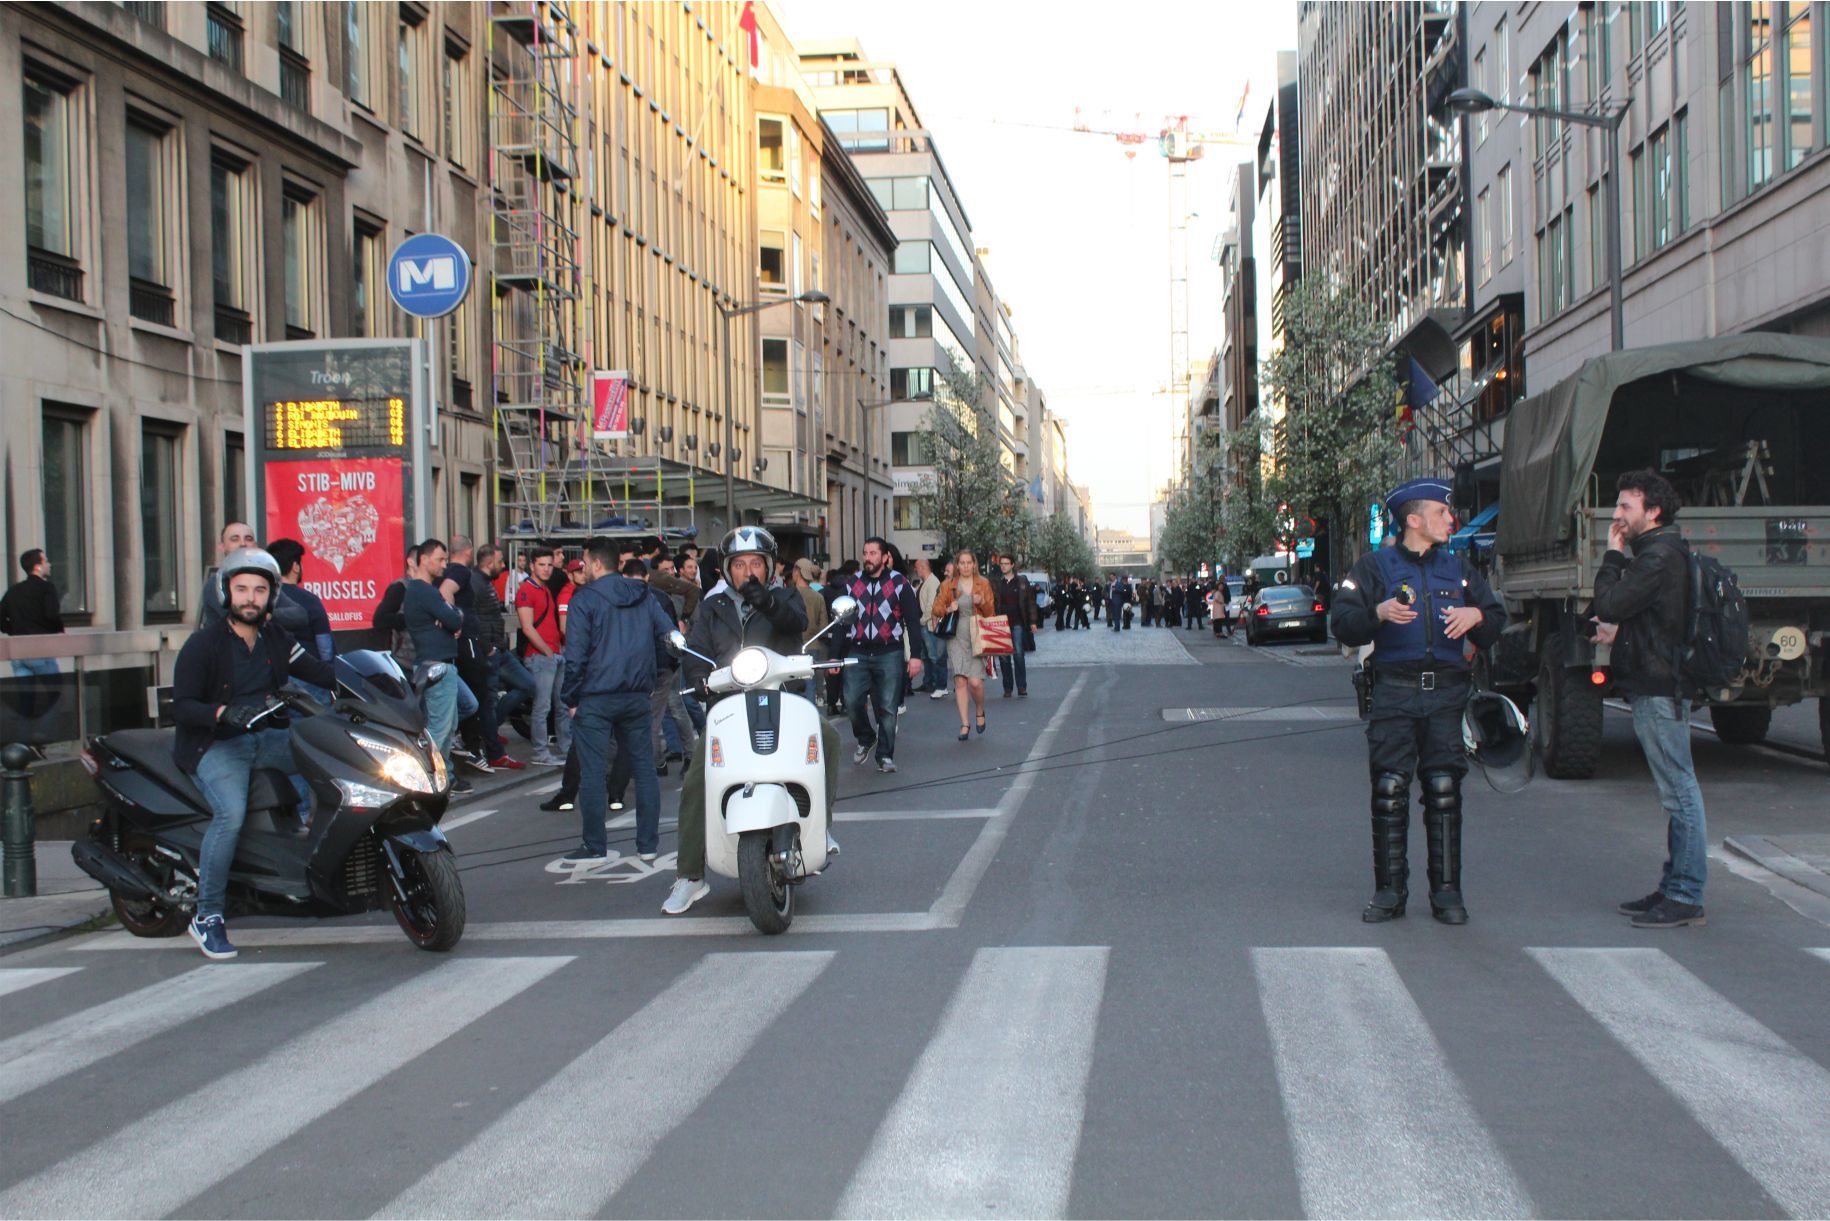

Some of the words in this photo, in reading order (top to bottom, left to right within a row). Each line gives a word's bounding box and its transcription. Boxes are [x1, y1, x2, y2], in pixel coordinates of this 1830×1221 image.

[400, 257, 455, 292] M
[288, 420, 329, 431] SIMONIS
[298, 471, 376, 492] STIB-MIVB
[304, 580, 376, 600] BRUSSELS
[327, 611, 363, 621] SALLOFUS
[1780, 635, 1797, 647] 60
